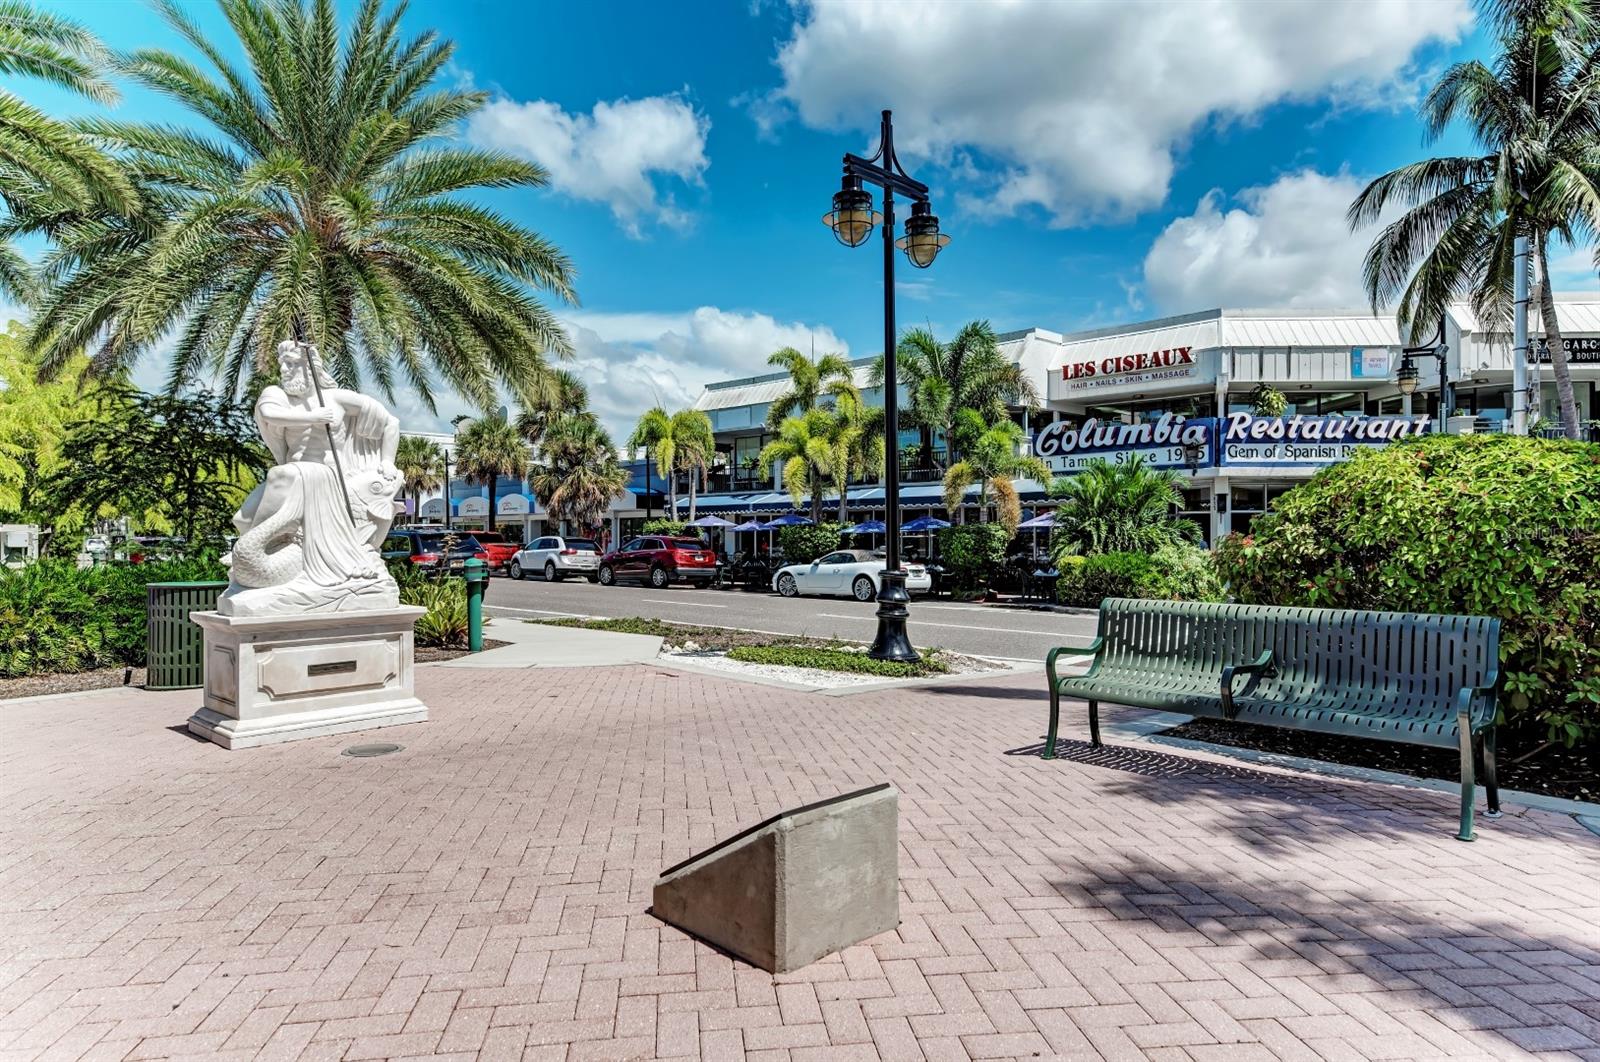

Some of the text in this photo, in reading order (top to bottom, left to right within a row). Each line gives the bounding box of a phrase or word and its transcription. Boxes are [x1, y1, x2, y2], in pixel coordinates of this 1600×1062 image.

[1563, 339, 1599, 349] GARC
[1062, 346, 1194, 380] LES CISEAUX
[1070, 369, 1190, 390] HAIR NAILS SKIN MASSAGE
[1035, 411, 1431, 456] Columbia Restaurant
[1115, 451, 1158, 465] Sice
[1166, 447, 1205, 462] 195
[1227, 444, 1258, 458] Gem
[1264, 444, 1278, 458] of
[1284, 444, 1337, 461] Spanish
